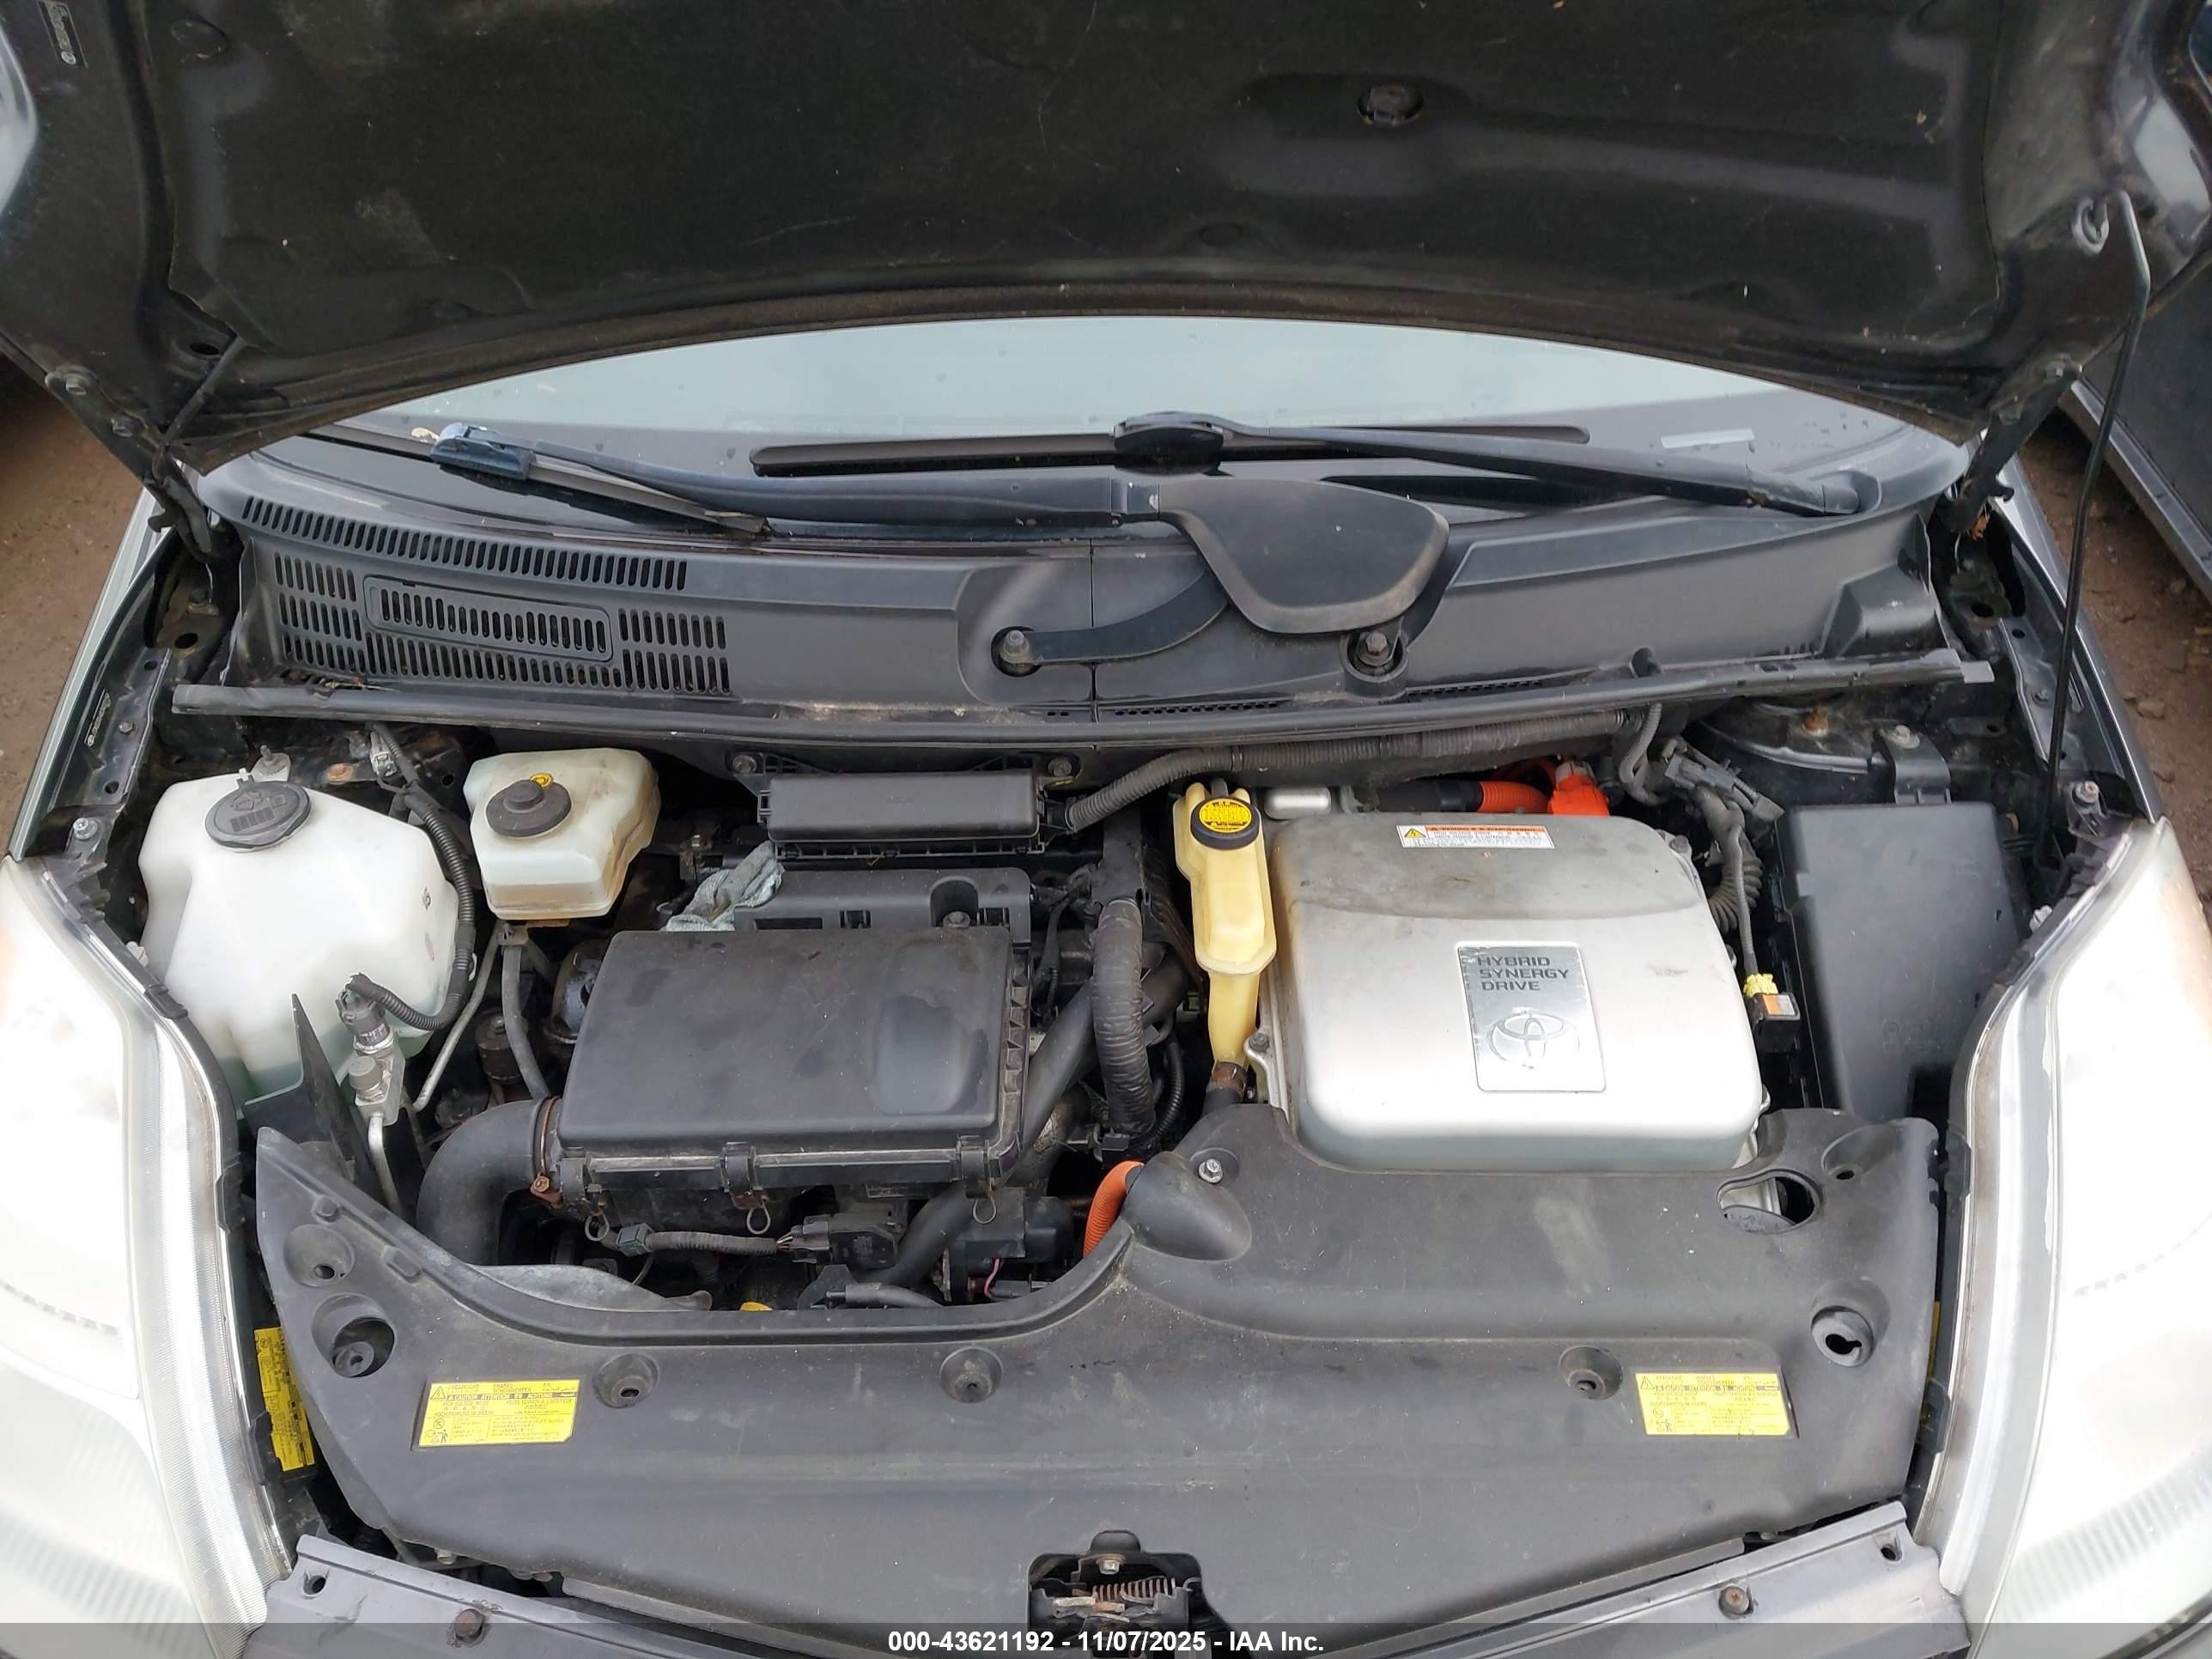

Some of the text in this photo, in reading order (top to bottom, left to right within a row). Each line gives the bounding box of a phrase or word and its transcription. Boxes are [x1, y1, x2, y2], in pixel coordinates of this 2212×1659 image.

[1477, 956, 1551, 967] HYBRID
[1479, 968, 1570, 979] SYNERGY
[1481, 981, 1540, 991] DRIVE
